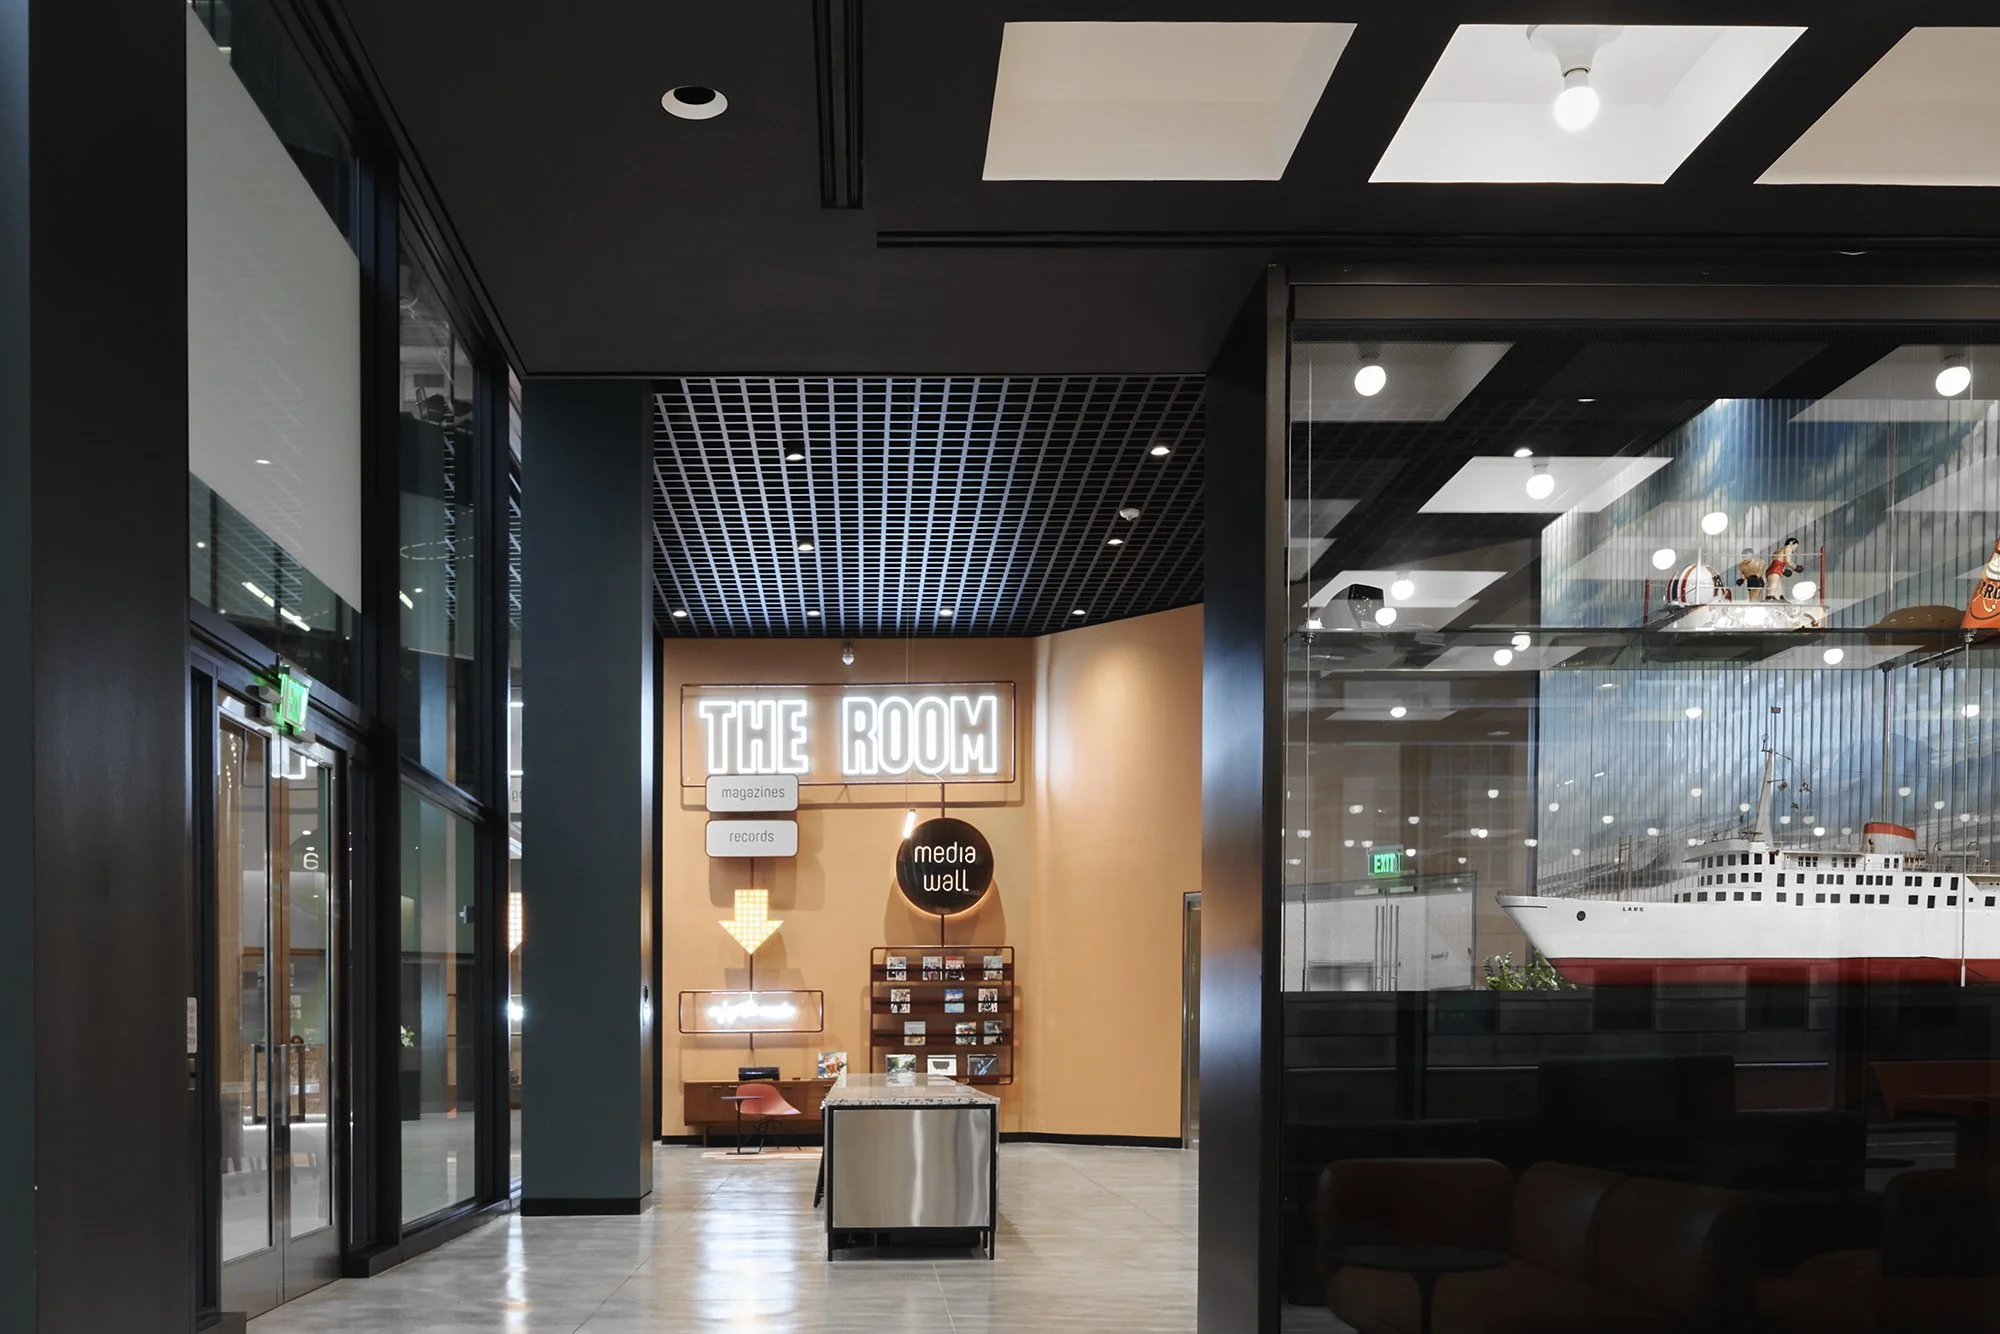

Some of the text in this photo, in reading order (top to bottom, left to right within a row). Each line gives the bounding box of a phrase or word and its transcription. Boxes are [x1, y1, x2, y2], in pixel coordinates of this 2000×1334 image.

[698, 695, 998, 776] THE ROOM
[721, 785, 785, 801] magazines
[729, 830, 775, 843] records
[914, 841, 976, 863] media
[1374, 853, 1396, 873] EXIT
[923, 869, 970, 892] wall
